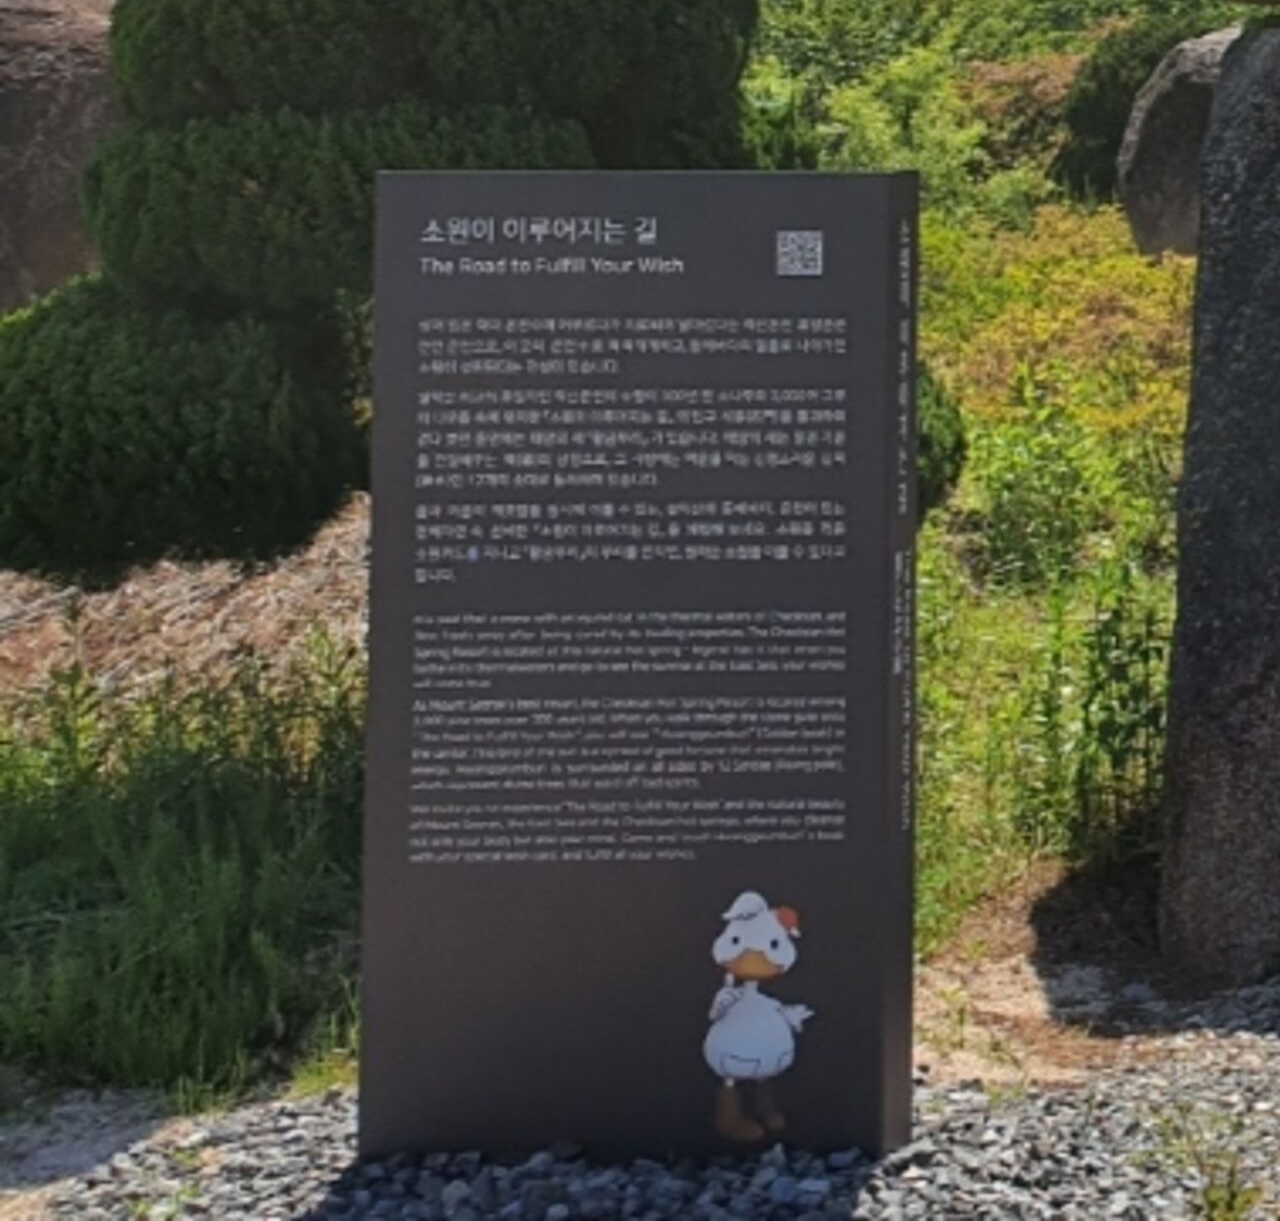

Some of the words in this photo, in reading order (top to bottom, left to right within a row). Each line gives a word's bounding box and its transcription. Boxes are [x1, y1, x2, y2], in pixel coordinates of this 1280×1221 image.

[420, 217, 495, 245] 소원이
[502, 217, 627, 245] 이루어지는
[634, 217, 658, 245] 길
[419, 257, 454, 274] The
[459, 257, 507, 274] Road
[510, 258, 531, 274] to
[535, 257, 587, 274] Fulfill
[590, 257, 634, 274] Your
[637, 257, 685, 274] Wish
